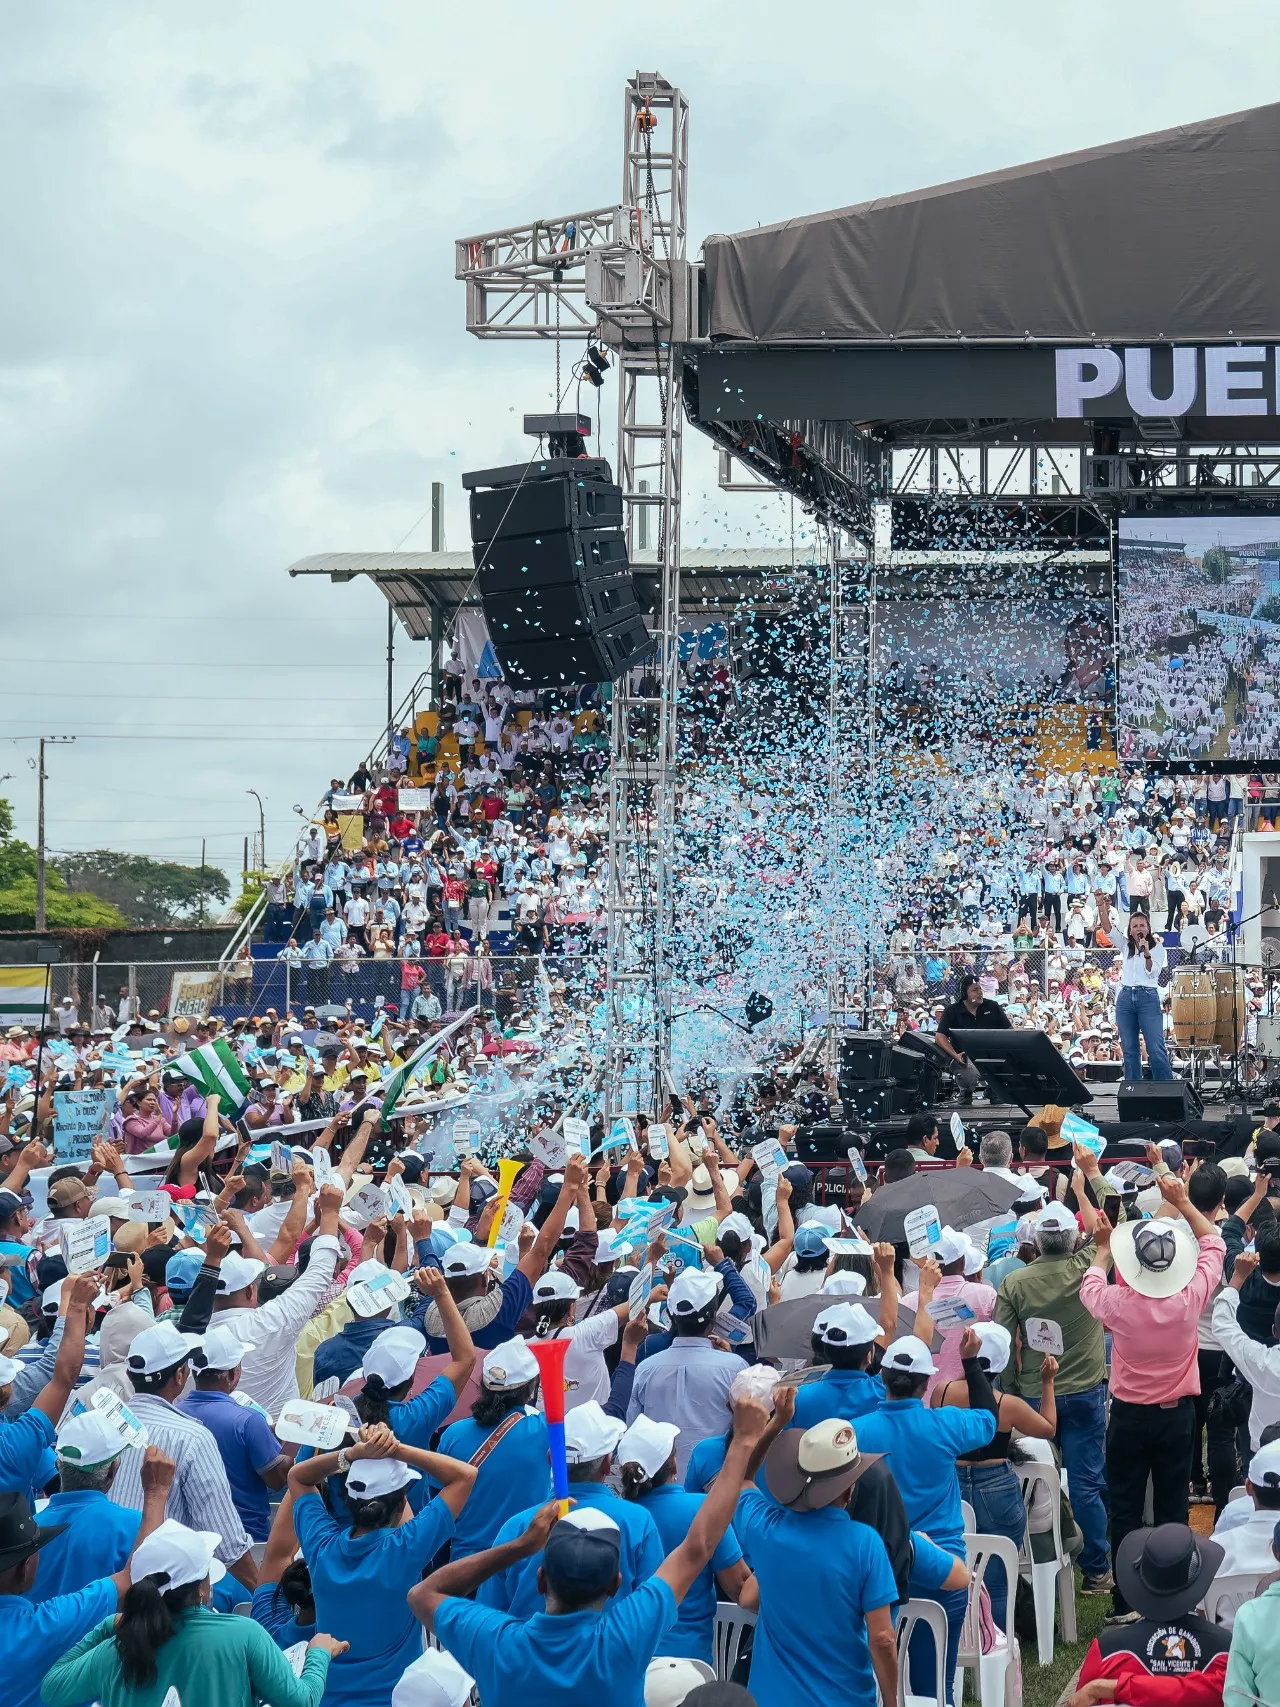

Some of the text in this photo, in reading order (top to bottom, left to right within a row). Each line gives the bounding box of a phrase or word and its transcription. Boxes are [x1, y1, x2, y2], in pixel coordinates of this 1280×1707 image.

[317, 1408, 334, 1442] MARCELA
[1168, 1626, 1177, 1634] DE
[1167, 1659, 1191, 1668] VICENTE
